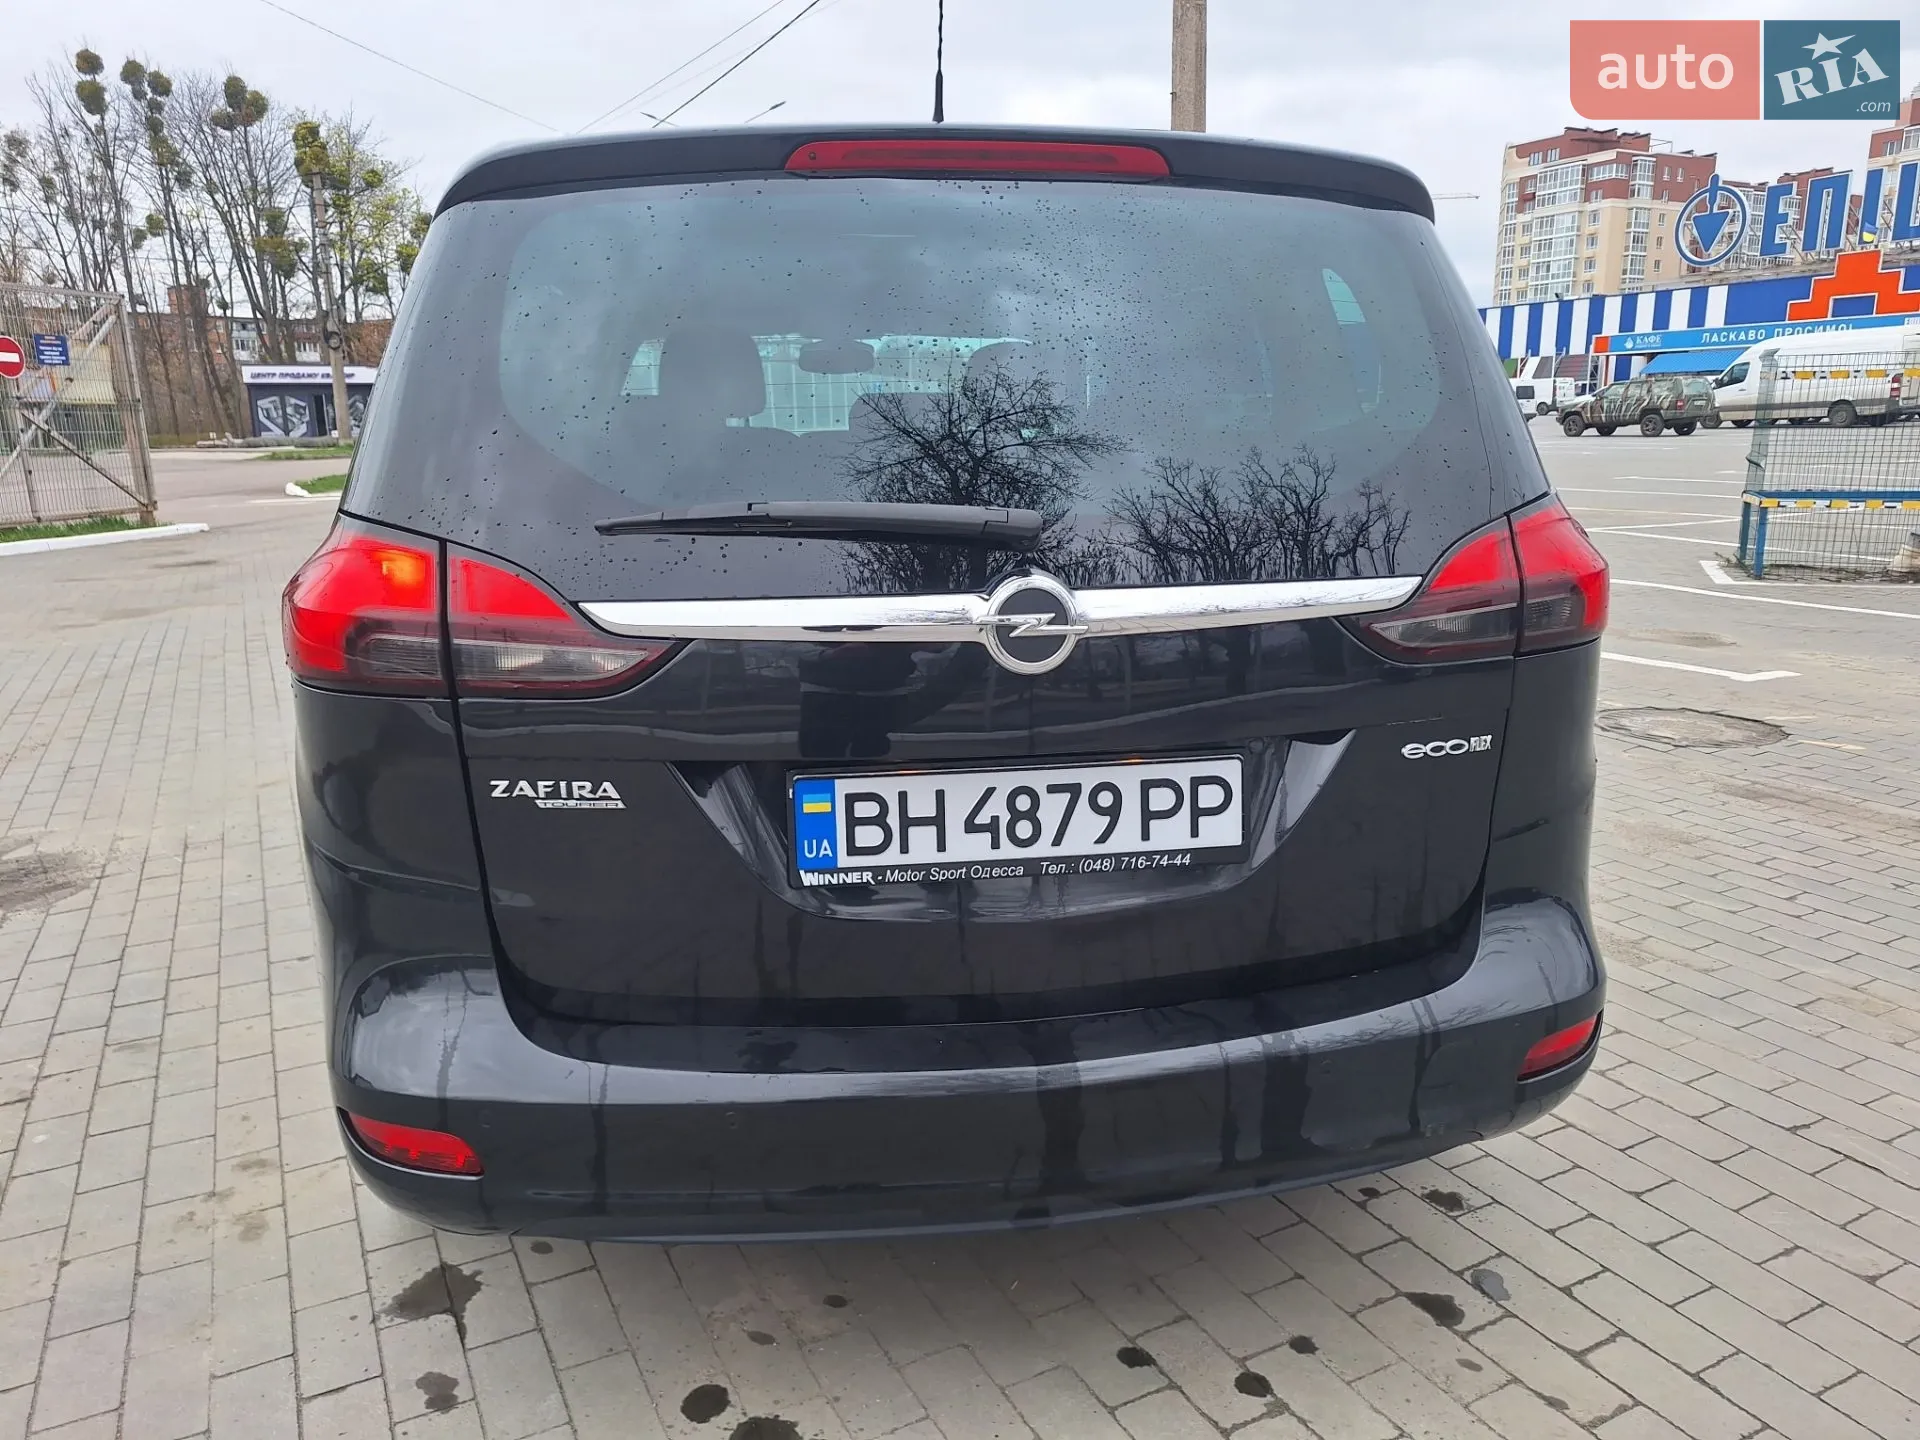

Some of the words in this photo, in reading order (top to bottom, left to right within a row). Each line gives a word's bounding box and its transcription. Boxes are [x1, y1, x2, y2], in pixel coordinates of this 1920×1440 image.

[1635, 334, 1662, 344] КАФЕ
[1701, 329, 1766, 343] ЛАСКАВО
[489, 780, 622, 799] ZAFIRA
[538, 799, 621, 809] TOURER
[843, 788, 947, 857] BH
[964, 781, 1123, 850] 4879
[1139, 775, 1234, 842] PP
[803, 839, 833, 858] UA
[1079, 857, 1116, 875] (048)
[1120, 853, 1192, 870] 716-74-44
[799, 869, 876, 887] WINNER
[885, 868, 926, 883] Motor
[929, 866, 967, 882] Sport
[970, 865, 1024, 879] Одесса
